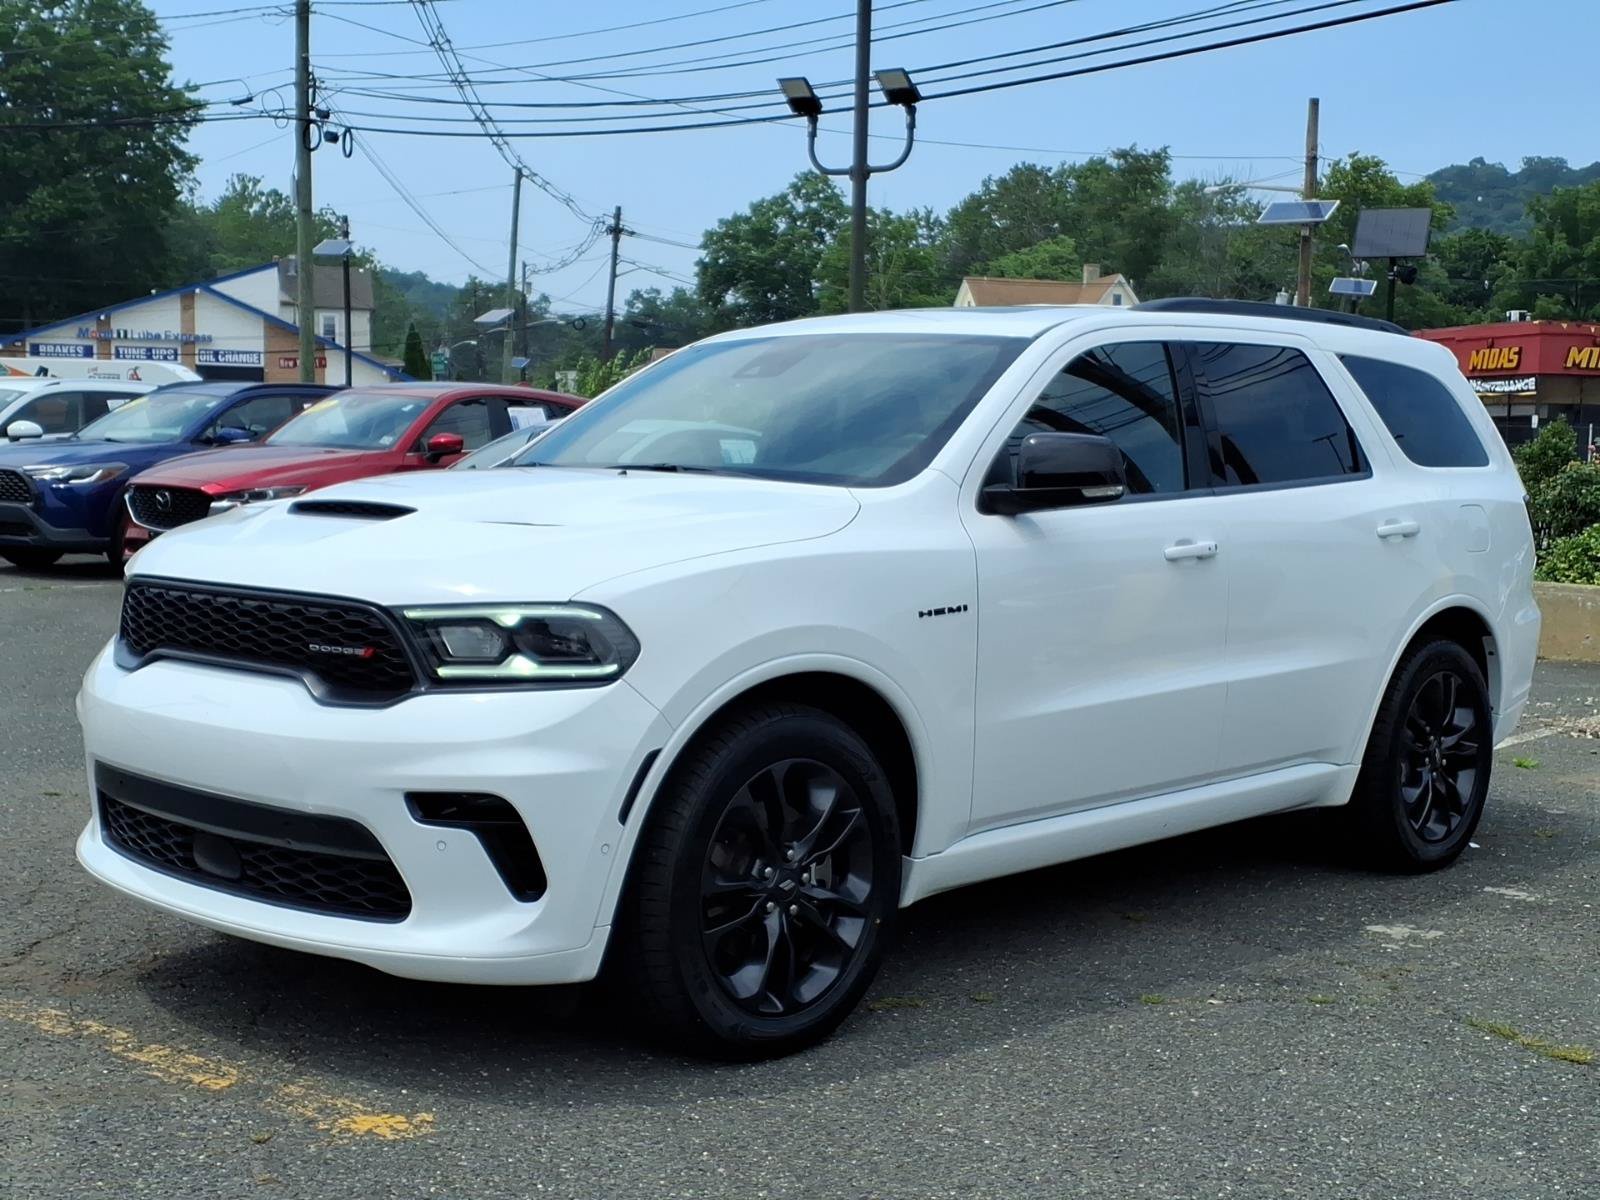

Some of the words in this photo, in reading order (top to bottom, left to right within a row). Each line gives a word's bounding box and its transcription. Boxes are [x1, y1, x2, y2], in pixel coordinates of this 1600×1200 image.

[131, 329, 161, 341] Lube
[164, 330, 213, 344] Express
[39, 344, 84, 357] BRAKES
[118, 347, 176, 360] TUNE-UPS
[200, 350, 216, 362] OIL
[218, 352, 260, 364] CHANGE
[1468, 346, 1520, 370] MIDAS
[918, 604, 968, 618] HEMI
[309, 643, 365, 656] DODGE
